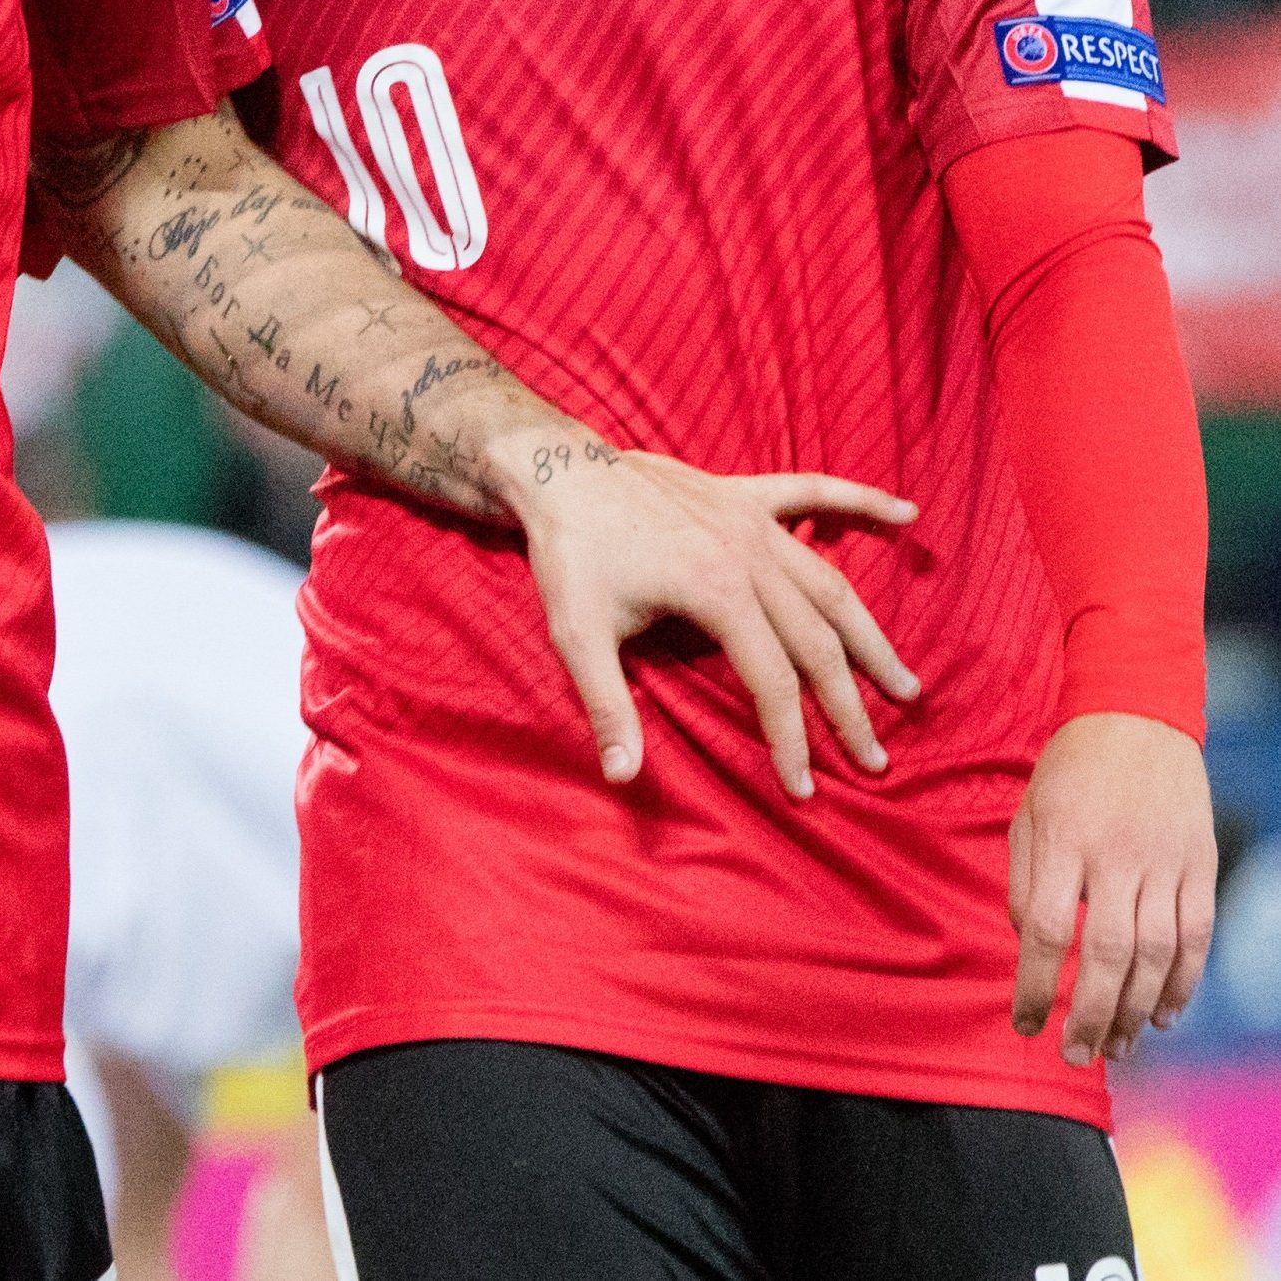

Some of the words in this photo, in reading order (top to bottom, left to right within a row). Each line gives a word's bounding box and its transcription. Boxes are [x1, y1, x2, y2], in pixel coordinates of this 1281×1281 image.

[1061, 33, 1159, 84] RESPECT
[299, 43, 488, 271] 10
[533, 444, 571, 485] 89
